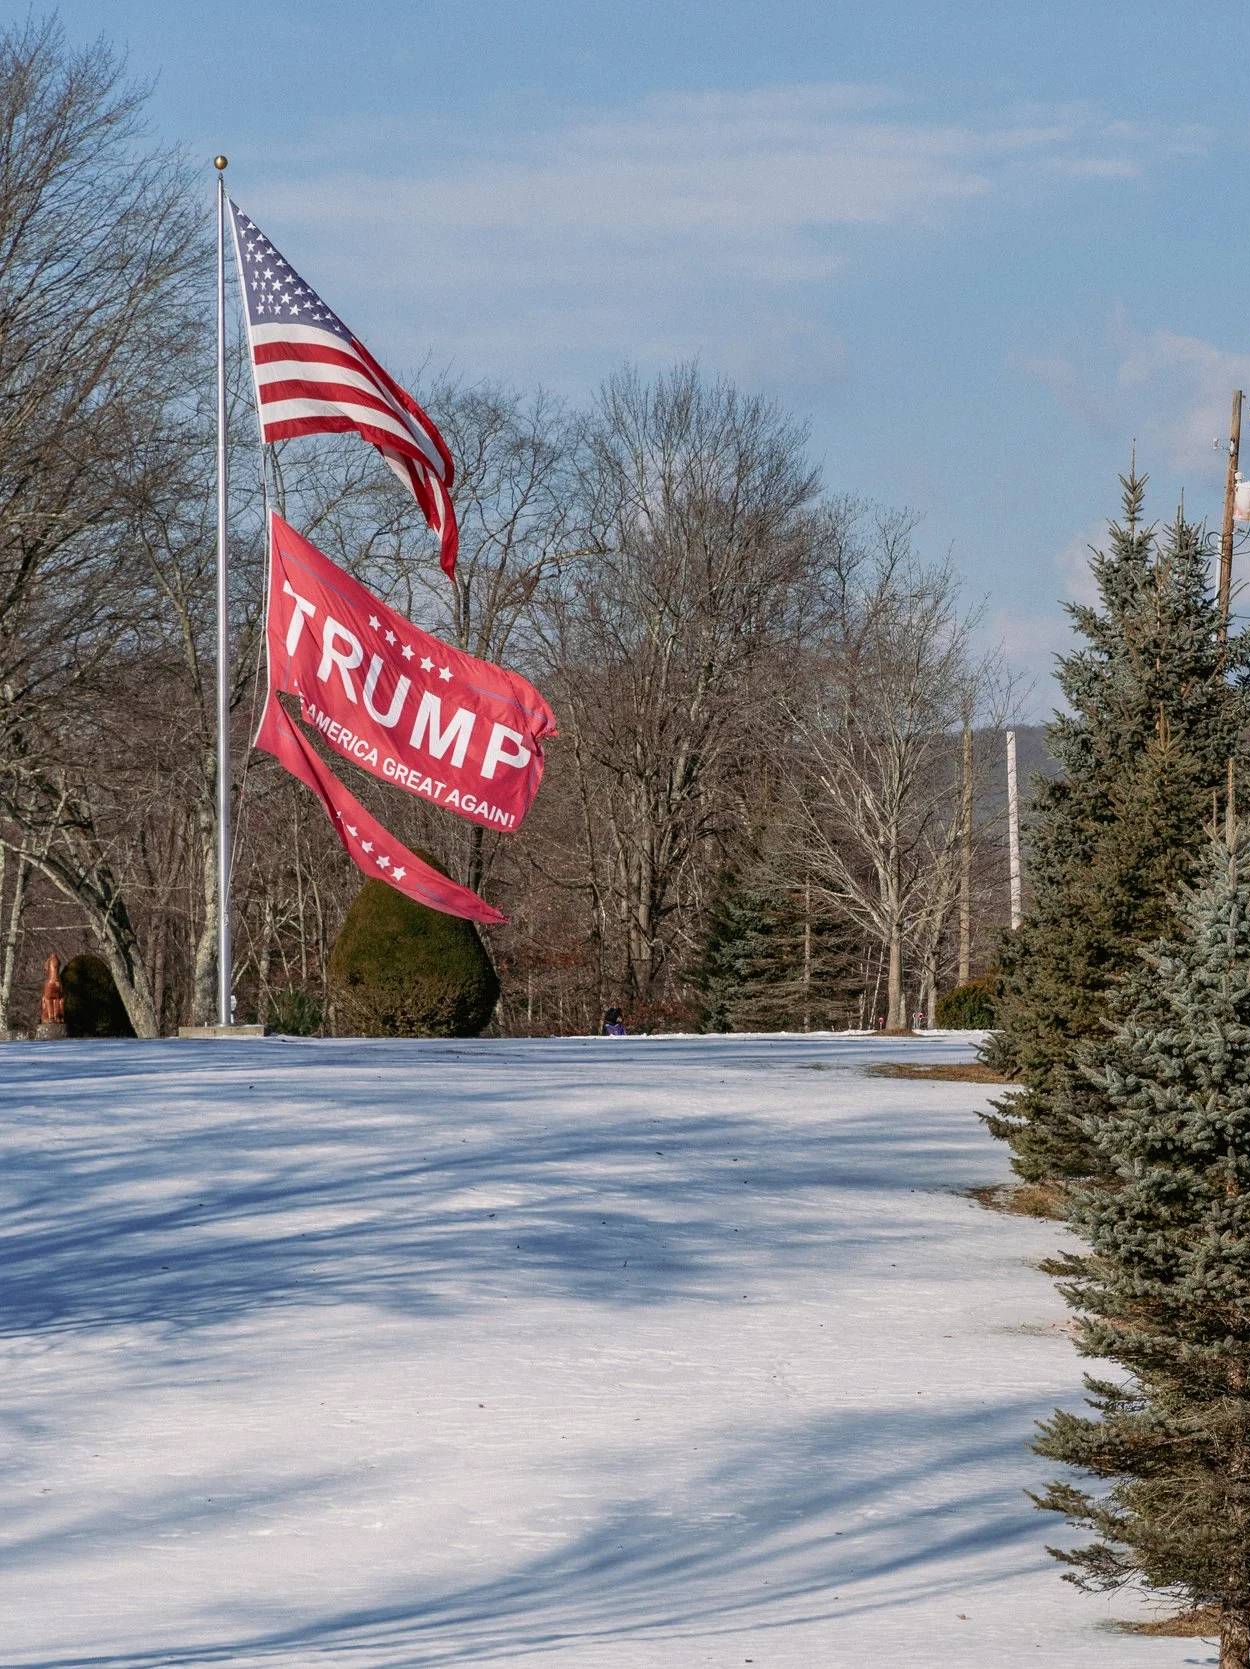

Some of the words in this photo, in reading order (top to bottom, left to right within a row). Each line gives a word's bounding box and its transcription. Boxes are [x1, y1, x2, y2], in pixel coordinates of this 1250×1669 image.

[283, 580, 532, 780] TRUMP
[306, 703, 379, 768] AMERICA
[382, 757, 447, 800] GREAT
[444, 788, 516, 828] AGAIN!
